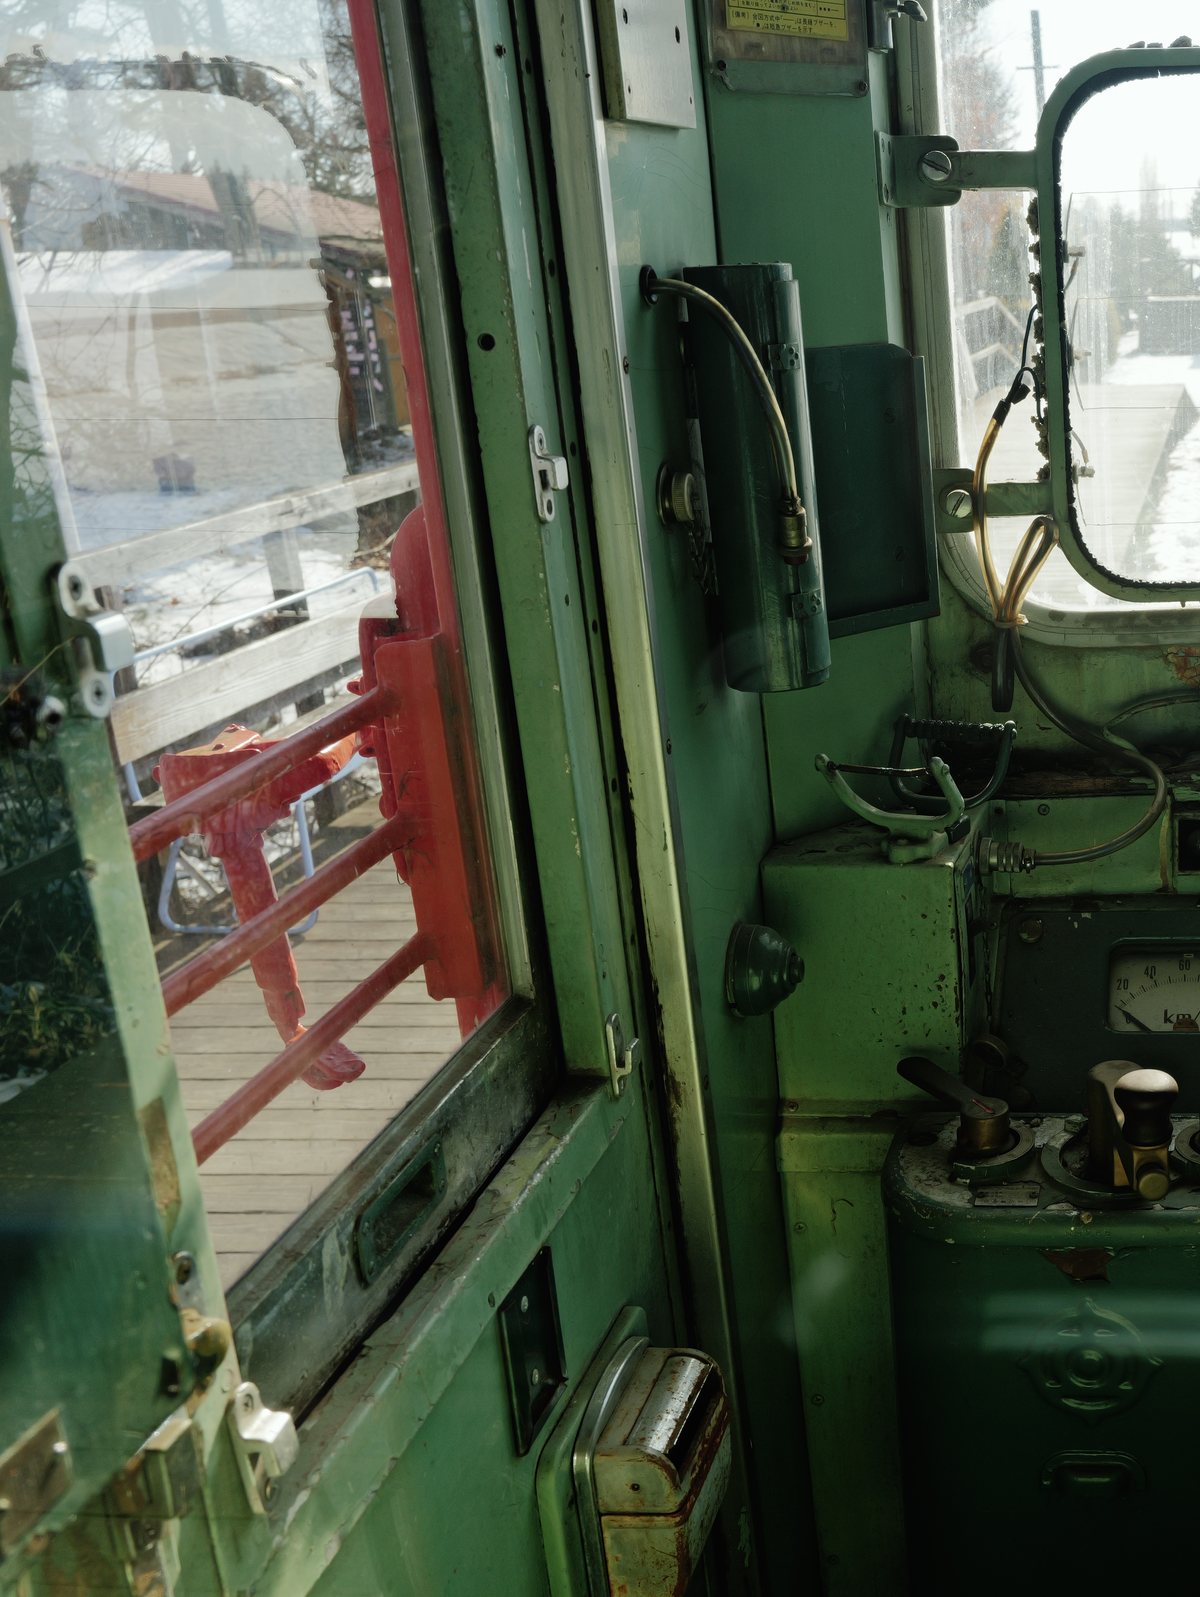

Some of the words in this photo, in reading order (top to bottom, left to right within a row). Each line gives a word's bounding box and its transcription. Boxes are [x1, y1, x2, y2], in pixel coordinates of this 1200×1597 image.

[1144, 965, 1156, 978] 40
[1178, 959, 1191, 971] 60
[1116, 978, 1129, 991] 20
